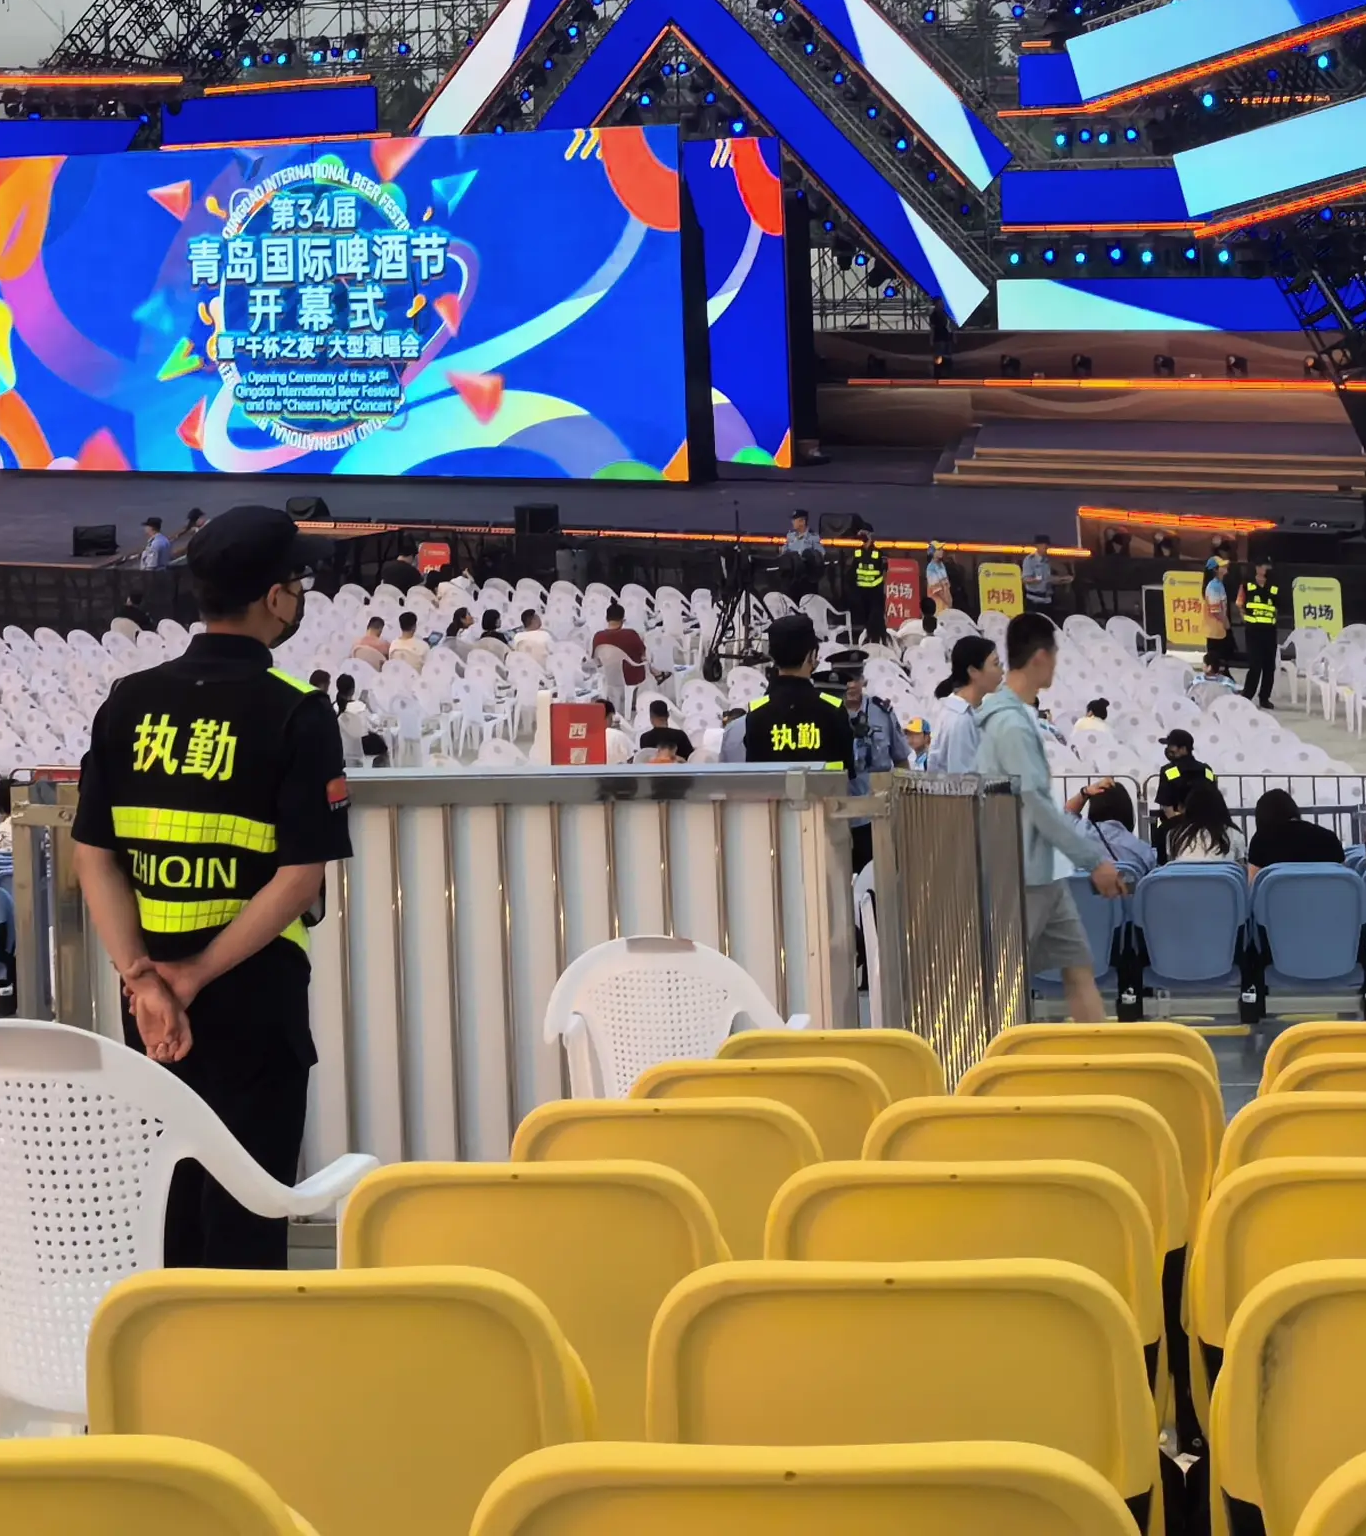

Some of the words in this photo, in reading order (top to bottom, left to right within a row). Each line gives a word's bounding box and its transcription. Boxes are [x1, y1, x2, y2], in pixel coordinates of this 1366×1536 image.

[264, 163, 351, 194] INTERNATIONAL
[351, 172, 382, 202] BEER
[271, 195, 357, 231] 第34届
[188, 234, 448, 285] 青岛国际啤酒节
[249, 286, 384, 332] 开幕式
[248, 371, 286, 385] Opening
[288, 371, 336, 385] Ceremony
[338, 371, 349, 383] of
[350, 371, 366, 383] the
[235, 385, 275, 399] Qingdao
[277, 385, 336, 397] International
[338, 385, 360, 397] Beer
[362, 384, 399, 397] Festival
[246, 400, 265, 412] and
[266, 400, 281, 412] the
[353, 400, 392, 412] Concert
[886, 582, 913, 599] 内场
[987, 589, 1015, 604] 内场
[1172, 597, 1202, 614] 内场
[1302, 603, 1334, 621] 内场
[133, 713, 238, 782] 执勤
[770, 722, 822, 751] 执勤
[127, 848, 238, 889] ZHIQIN
